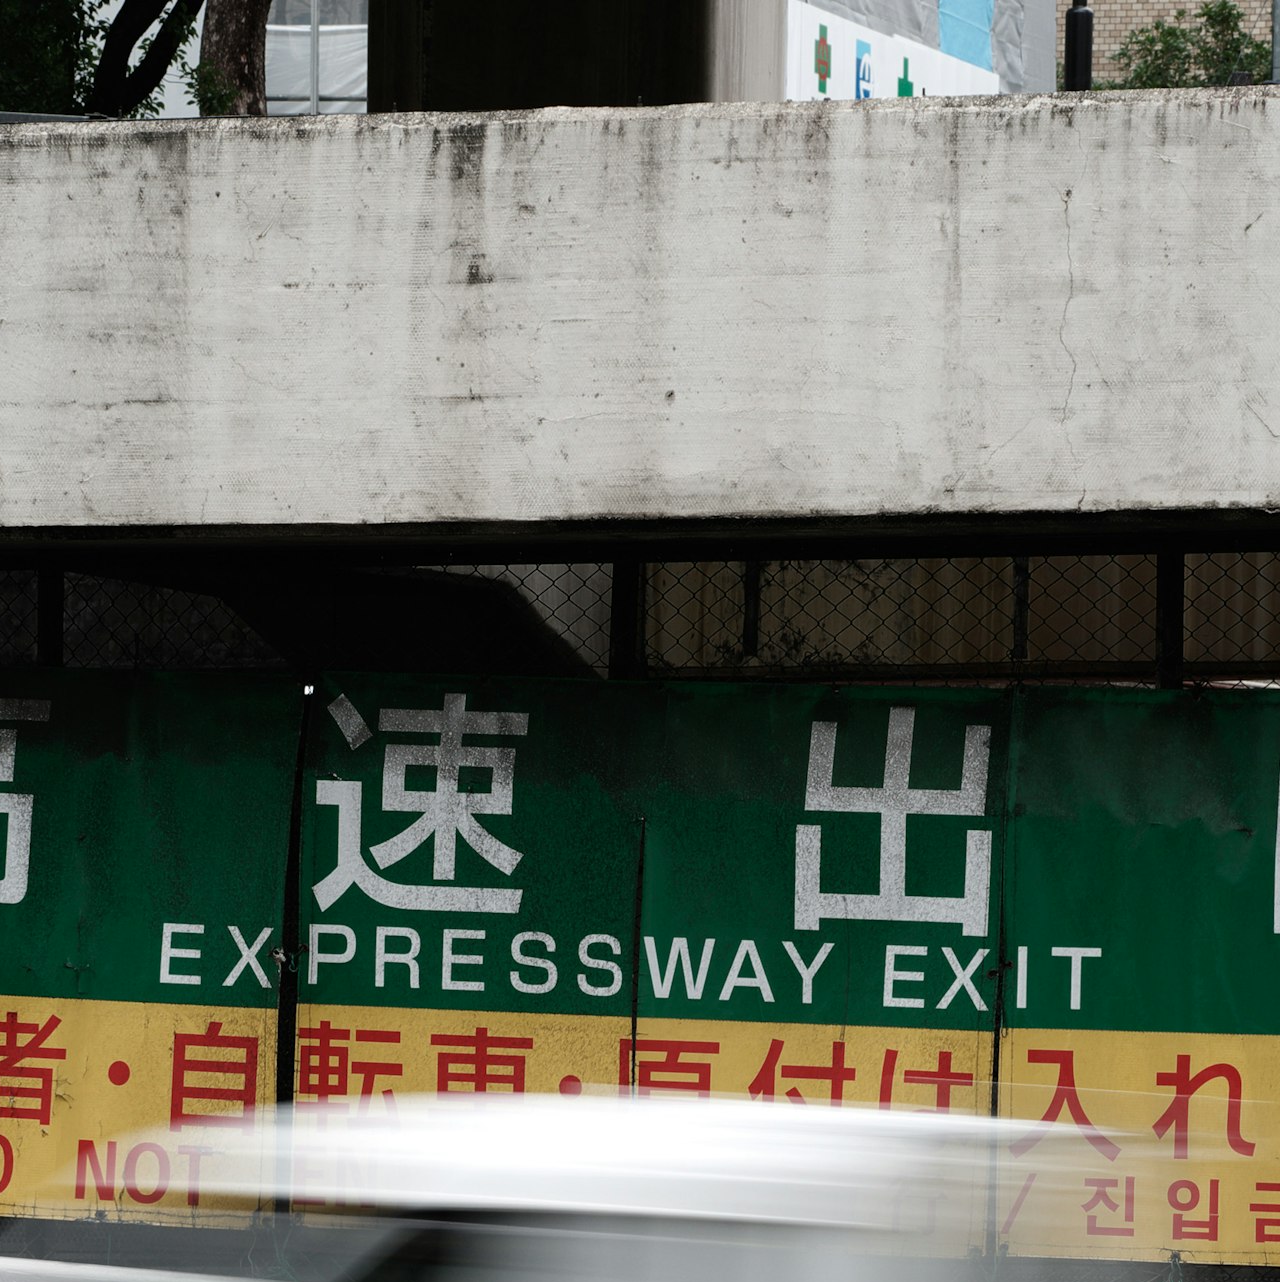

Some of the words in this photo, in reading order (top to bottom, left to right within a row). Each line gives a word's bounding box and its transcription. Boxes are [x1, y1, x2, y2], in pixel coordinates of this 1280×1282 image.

[159, 923, 835, 1006] EXPRESSWAY
[883, 945, 1103, 1012] EXIT
[75, 1140, 212, 1207] NOT
